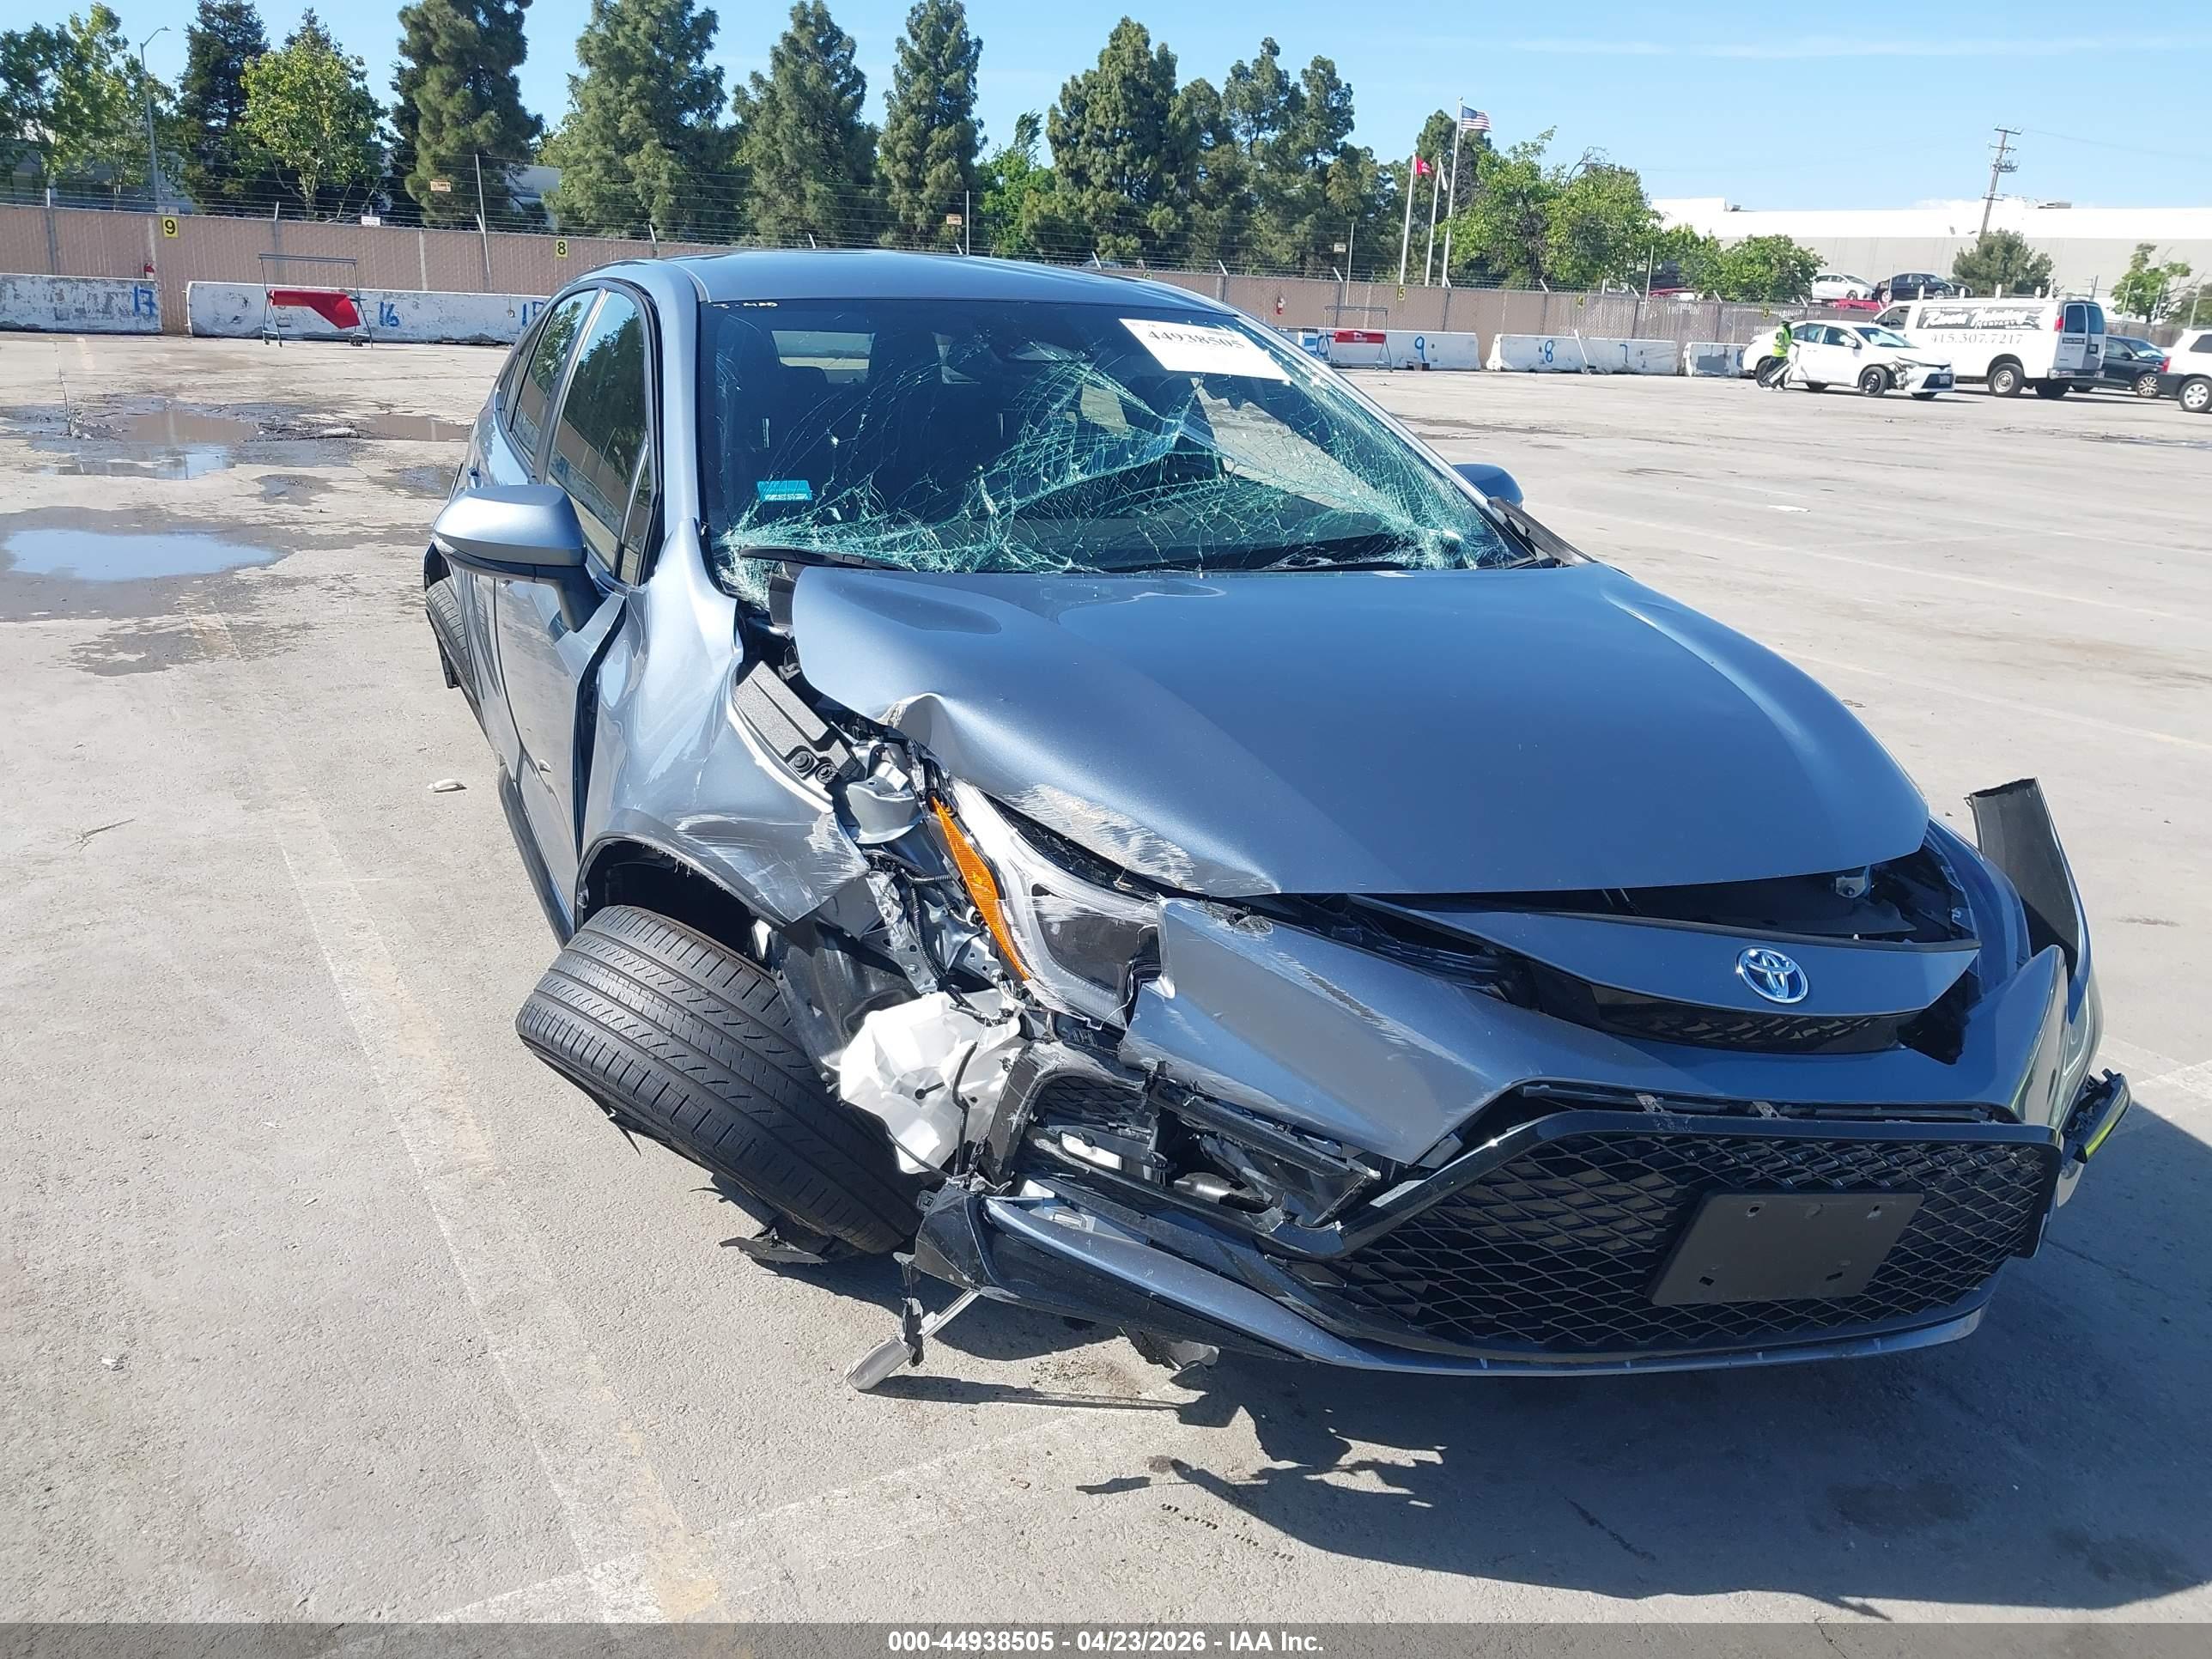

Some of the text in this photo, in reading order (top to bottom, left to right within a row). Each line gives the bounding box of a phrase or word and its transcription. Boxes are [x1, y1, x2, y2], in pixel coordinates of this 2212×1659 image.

[164, 219, 176, 234] 9
[557, 241, 567, 256] 8
[133, 286, 155, 317] 17
[1400, 288, 1405, 299] 5
[1578, 297, 1583, 307] 4
[379, 301, 400, 327] 16
[1764, 308, 1770, 318] 3
[1148, 330, 1245, 349] 44938505
[1414, 336, 1426, 362] 9
[1544, 339, 1554, 362] 8
[1620, 343, 1629, 364] 7
